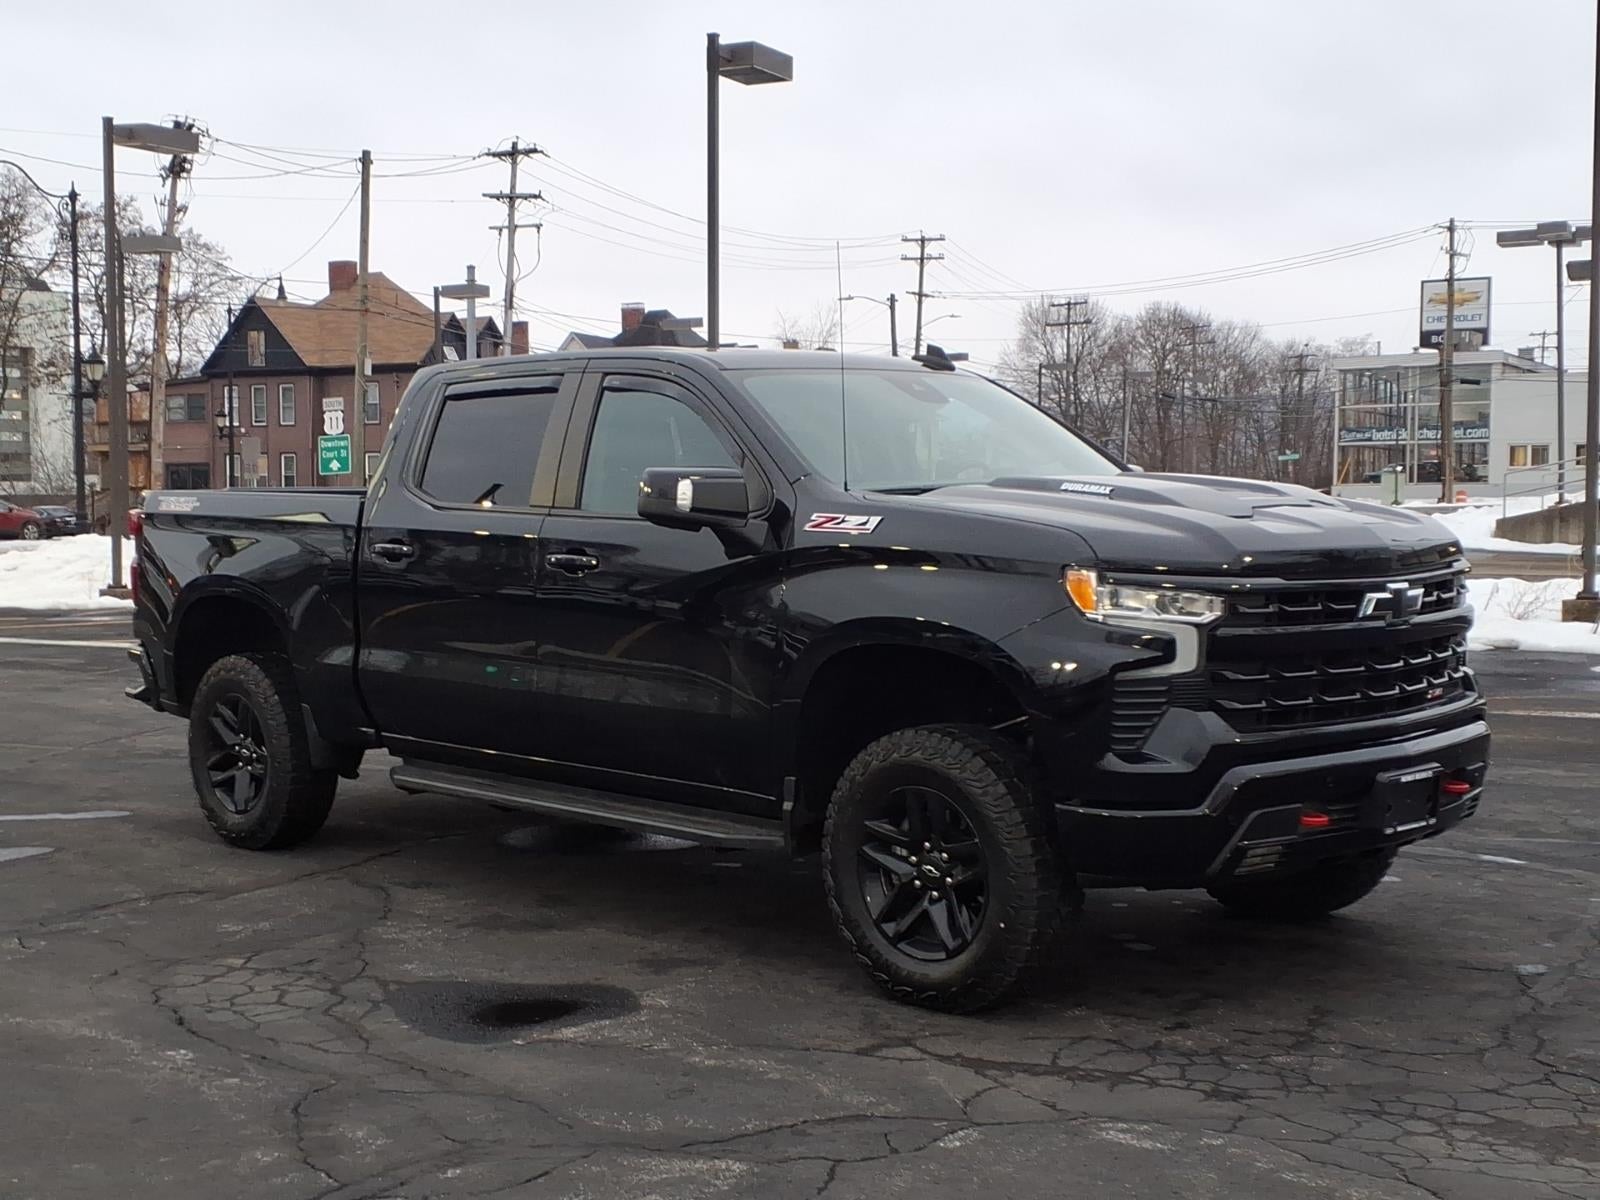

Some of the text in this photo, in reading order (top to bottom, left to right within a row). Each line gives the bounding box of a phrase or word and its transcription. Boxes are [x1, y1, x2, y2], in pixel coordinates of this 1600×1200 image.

[1426, 313, 1483, 324] CHEROLET
[329, 416, 339, 430] 11
[321, 440, 348, 448] Downtown
[322, 449, 347, 458] Court St
[1060, 482, 1114, 494] DURAMAX
[803, 512, 884, 534] Z71
